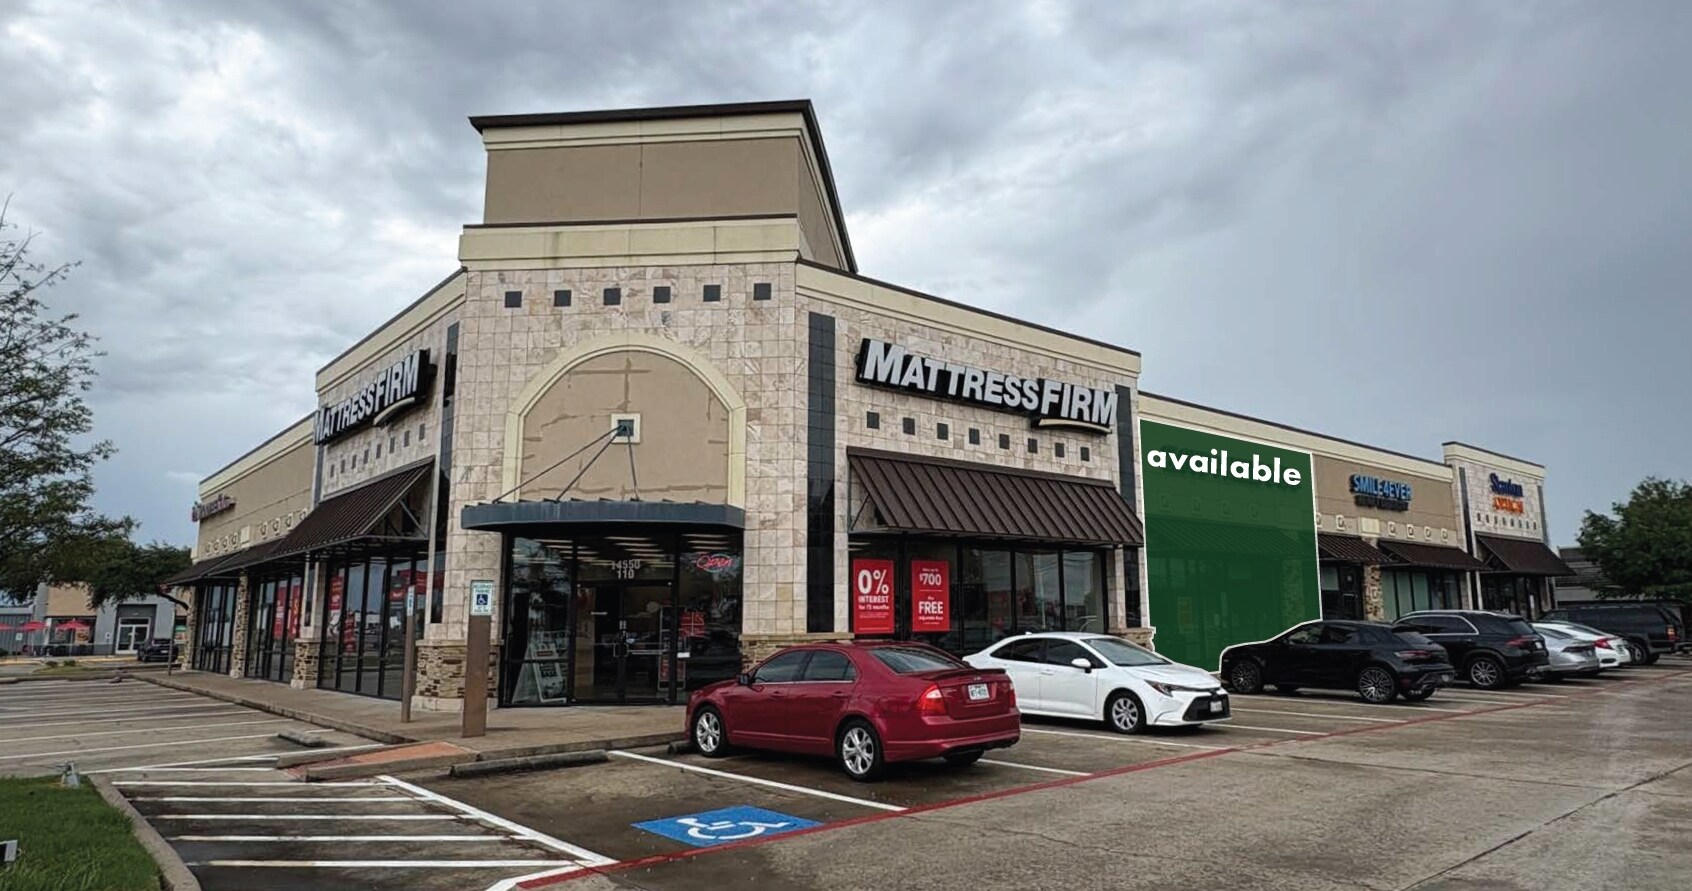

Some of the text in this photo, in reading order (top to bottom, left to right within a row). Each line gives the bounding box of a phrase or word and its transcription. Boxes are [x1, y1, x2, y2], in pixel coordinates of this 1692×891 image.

[1353, 474, 1412, 501] SMILE4EVER
[617, 569, 635, 579] 110
[919, 573, 942, 586] $700
[858, 569, 890, 595] 0%
[858, 595, 889, 603] INTEREST
[918, 601, 944, 614] FREE
